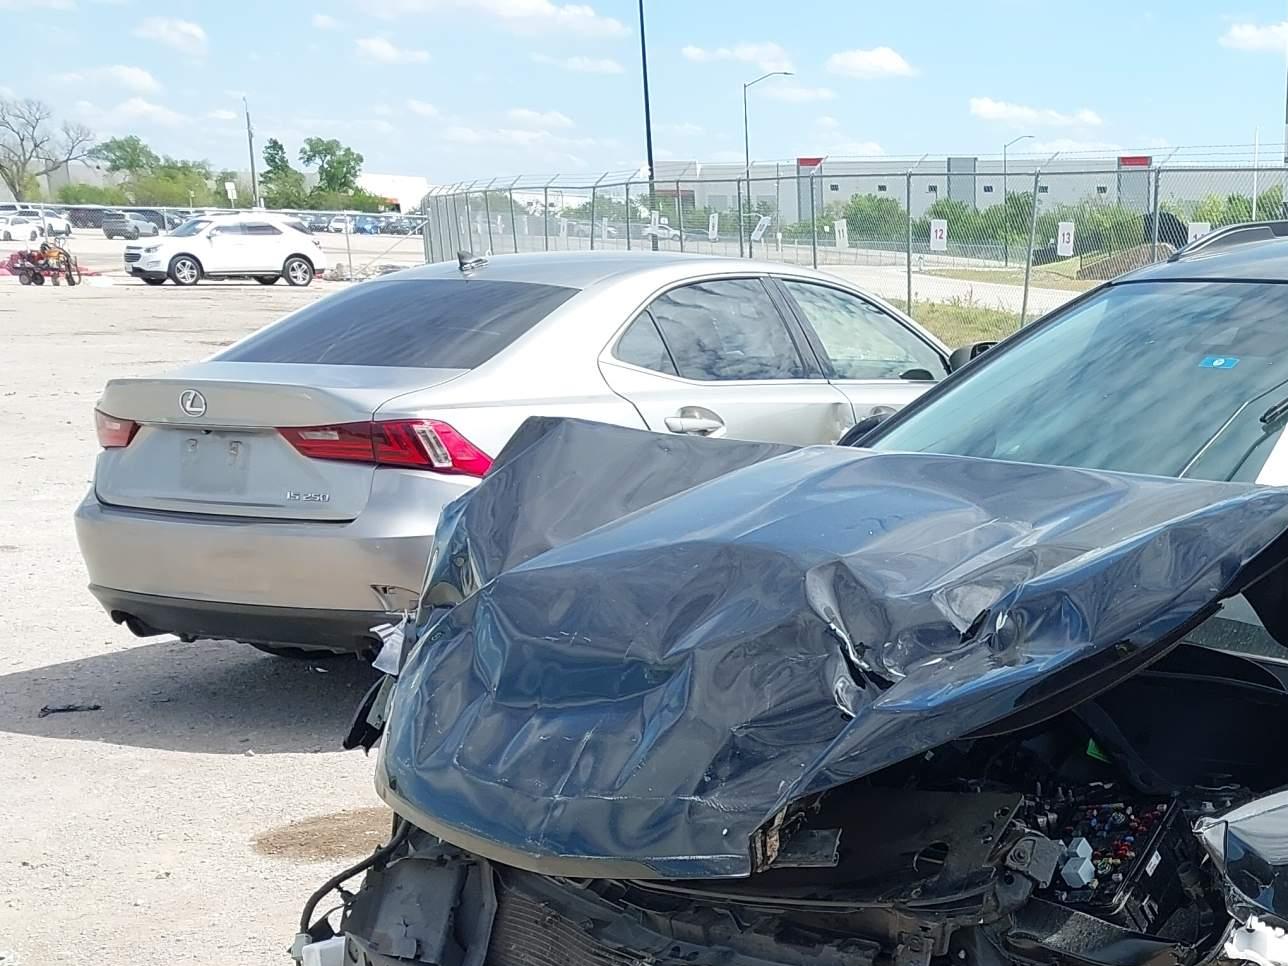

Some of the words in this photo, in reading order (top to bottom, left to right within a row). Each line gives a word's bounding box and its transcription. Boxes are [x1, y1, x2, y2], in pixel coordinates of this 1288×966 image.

[934, 228, 944, 240] 12
[1061, 232, 1071, 244] 13
[303, 493, 330, 502] 250
